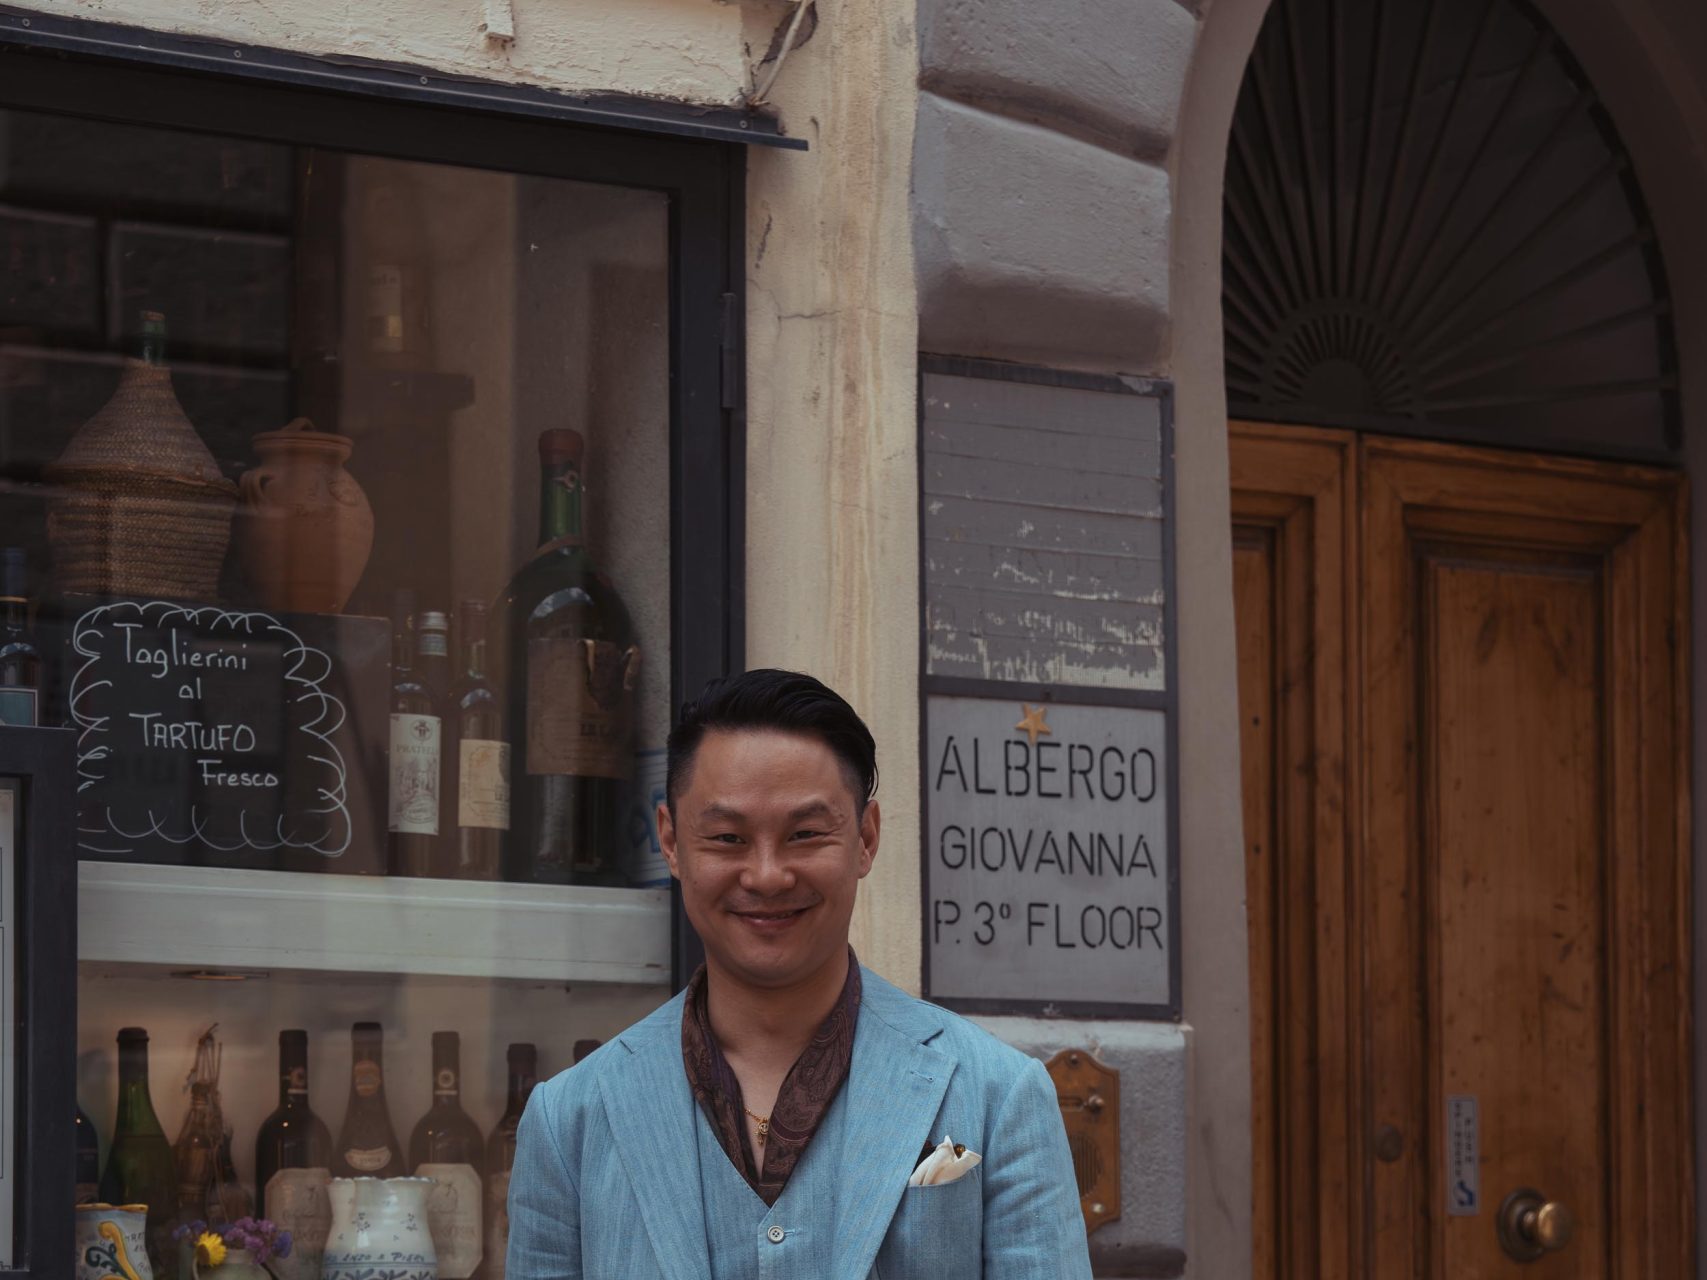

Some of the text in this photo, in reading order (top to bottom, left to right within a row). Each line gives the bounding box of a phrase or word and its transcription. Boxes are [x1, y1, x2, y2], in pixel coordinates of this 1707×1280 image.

[113, 622, 248, 679] Taglierini
[178, 677, 202, 700] al
[129, 712, 256, 752] TARTUFO
[197, 759, 279, 787] Fresco
[936, 735, 1157, 803] ALBERGO
[940, 824, 1158, 879] GIOVANNA
[1027, 902, 1164, 950] FLOOR
